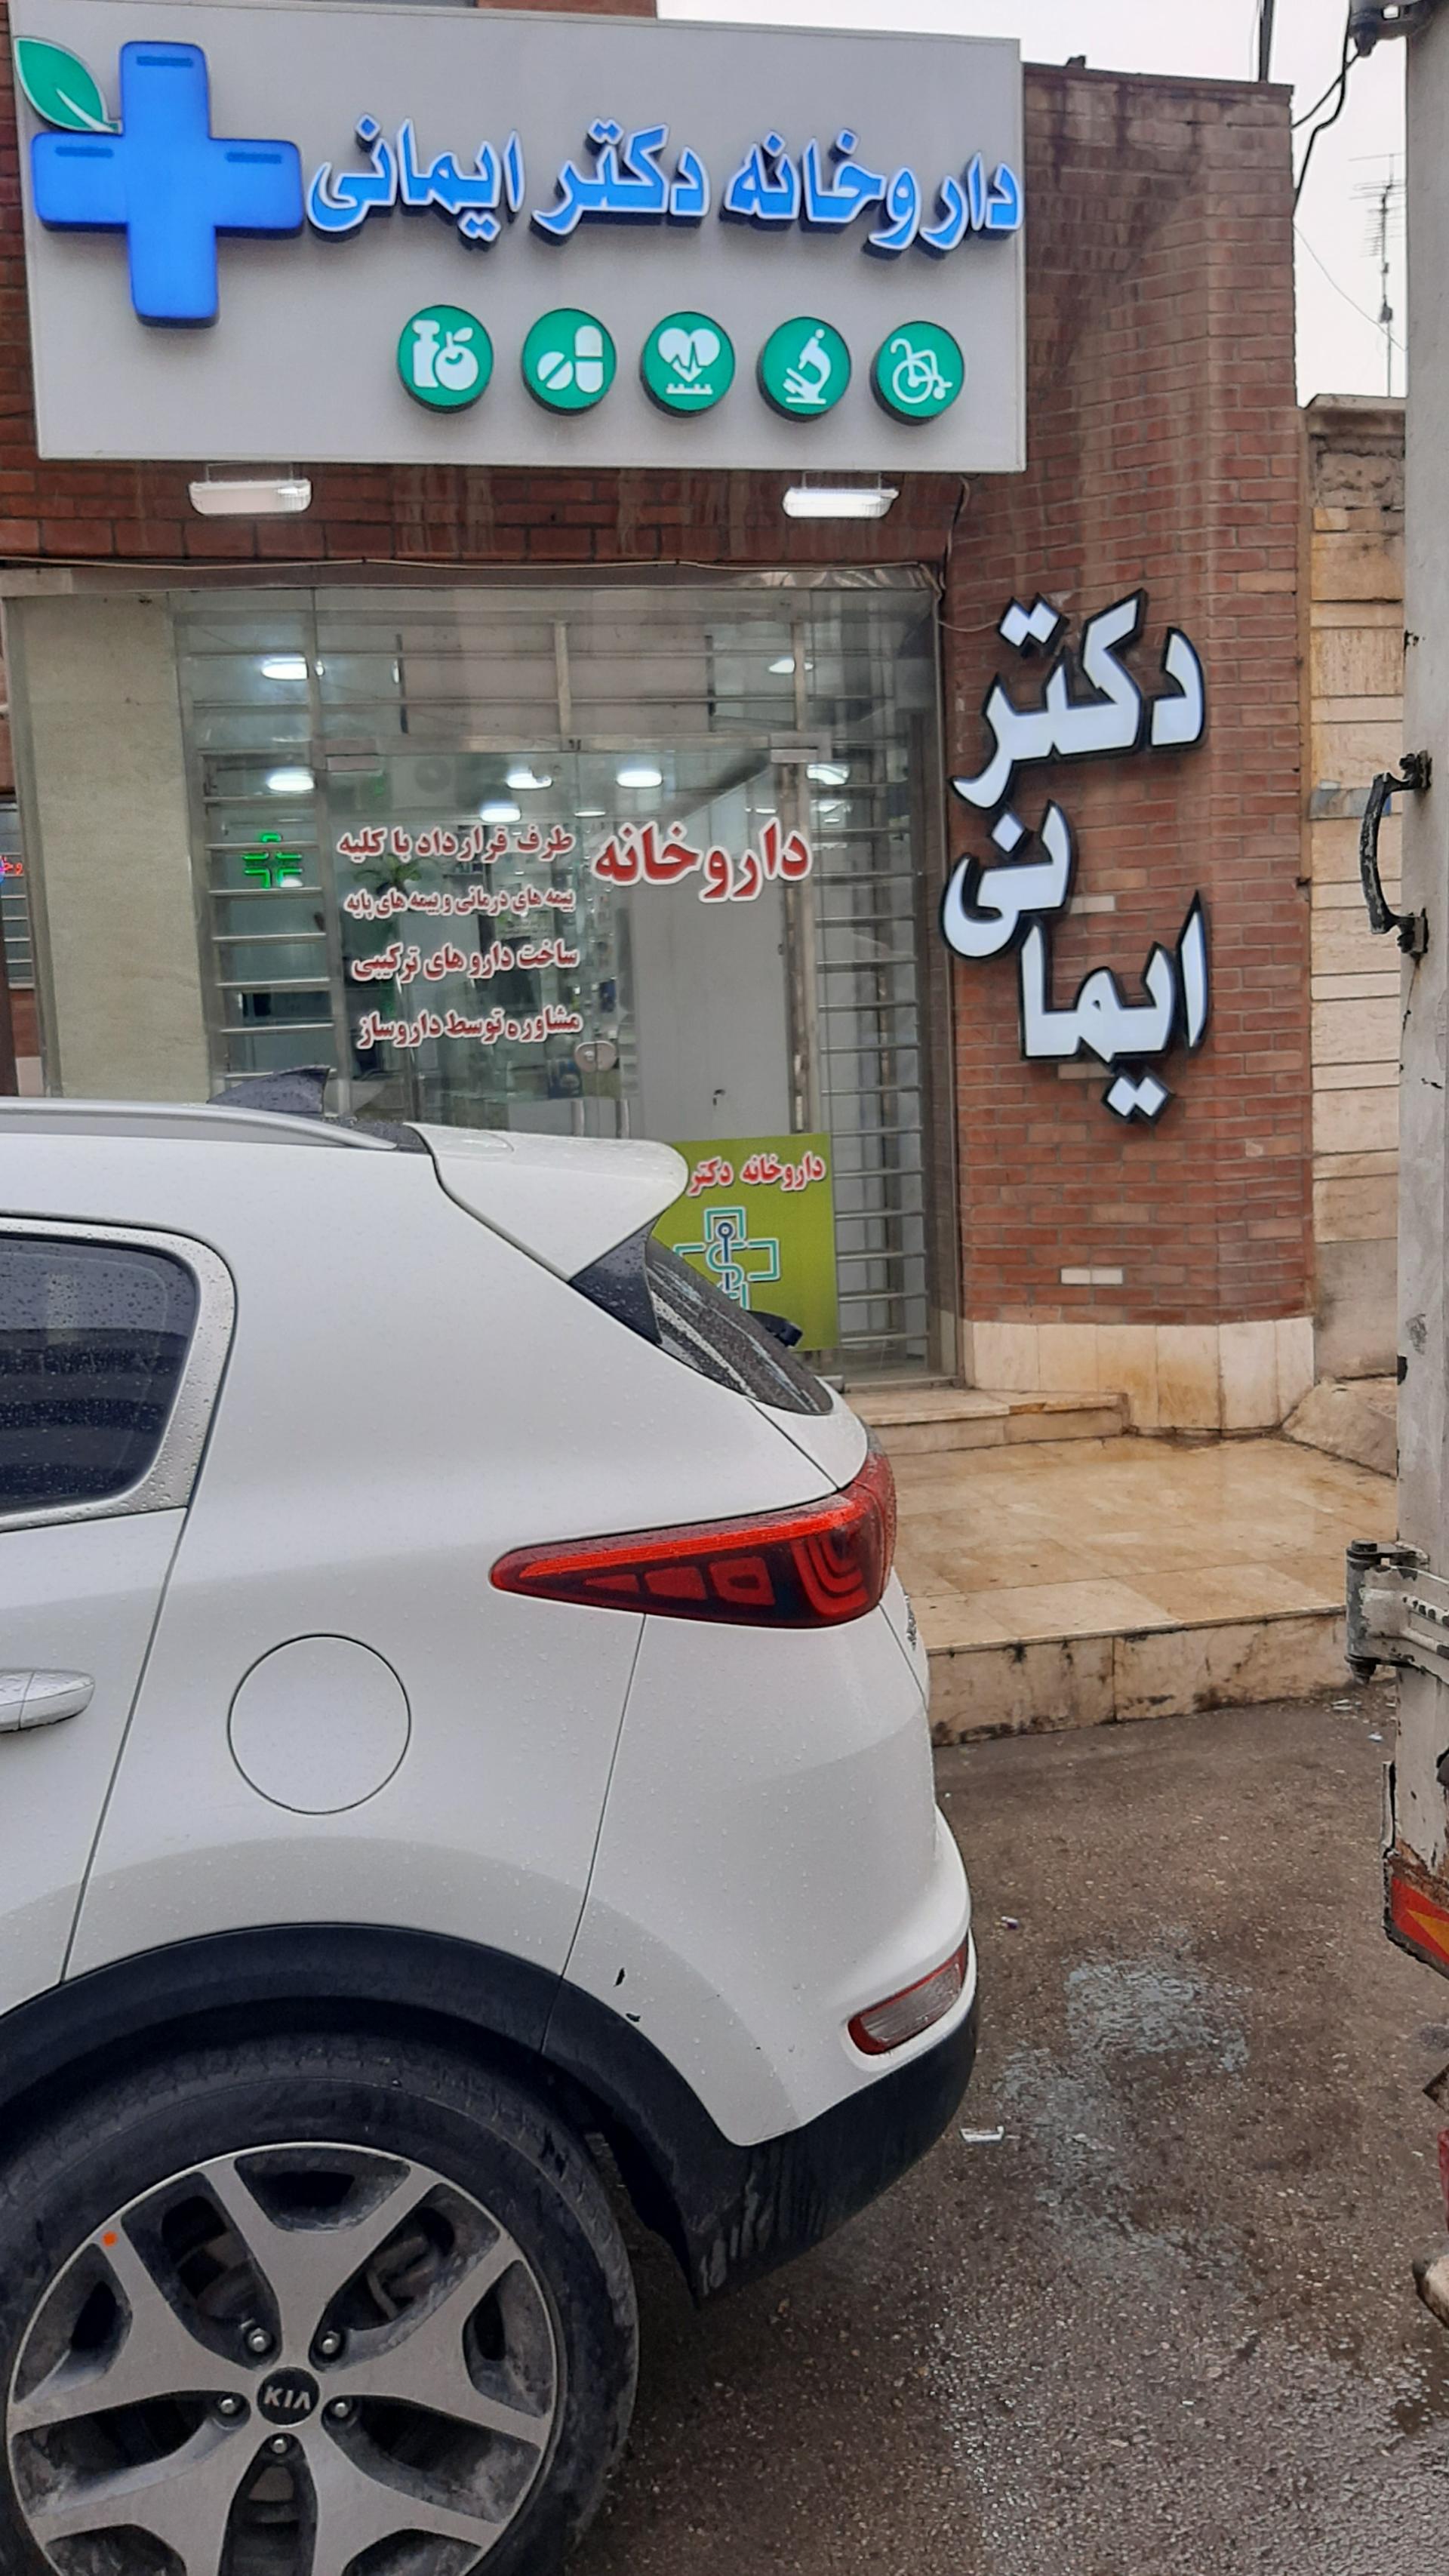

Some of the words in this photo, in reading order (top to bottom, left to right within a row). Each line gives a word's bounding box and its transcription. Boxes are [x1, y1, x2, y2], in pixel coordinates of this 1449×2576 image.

[306, 112, 525, 243] ایمانی
[531, 118, 710, 235] دکتر
[723, 127, 1024, 251] داروخانه
[950, 589, 1205, 810] دکتر
[337, 826, 386, 863] کلیه
[391, 826, 412, 860] با
[516, 823, 576, 860] طرف
[592, 816, 813, 903] داروخانه
[344, 888, 377, 920] پایه
[374, 886, 408, 919] های
[409, 891, 441, 914] بیمه
[454, 885, 509, 916] درمانی
[510, 885, 542, 912] های
[544, 887, 576, 913] بیمه
[351, 943, 420, 983] ترکیبی
[517, 939, 578, 971] ساخت
[356, 1011, 444, 1050] داروساز
[444, 1008, 506, 1046] توسط
[505, 1004, 583, 1043] مشاوره
[685, 1156, 734, 1198] دکتر
[739, 1150, 826, 1193] داروخانه
[264, 2386, 311, 2411] KIA
